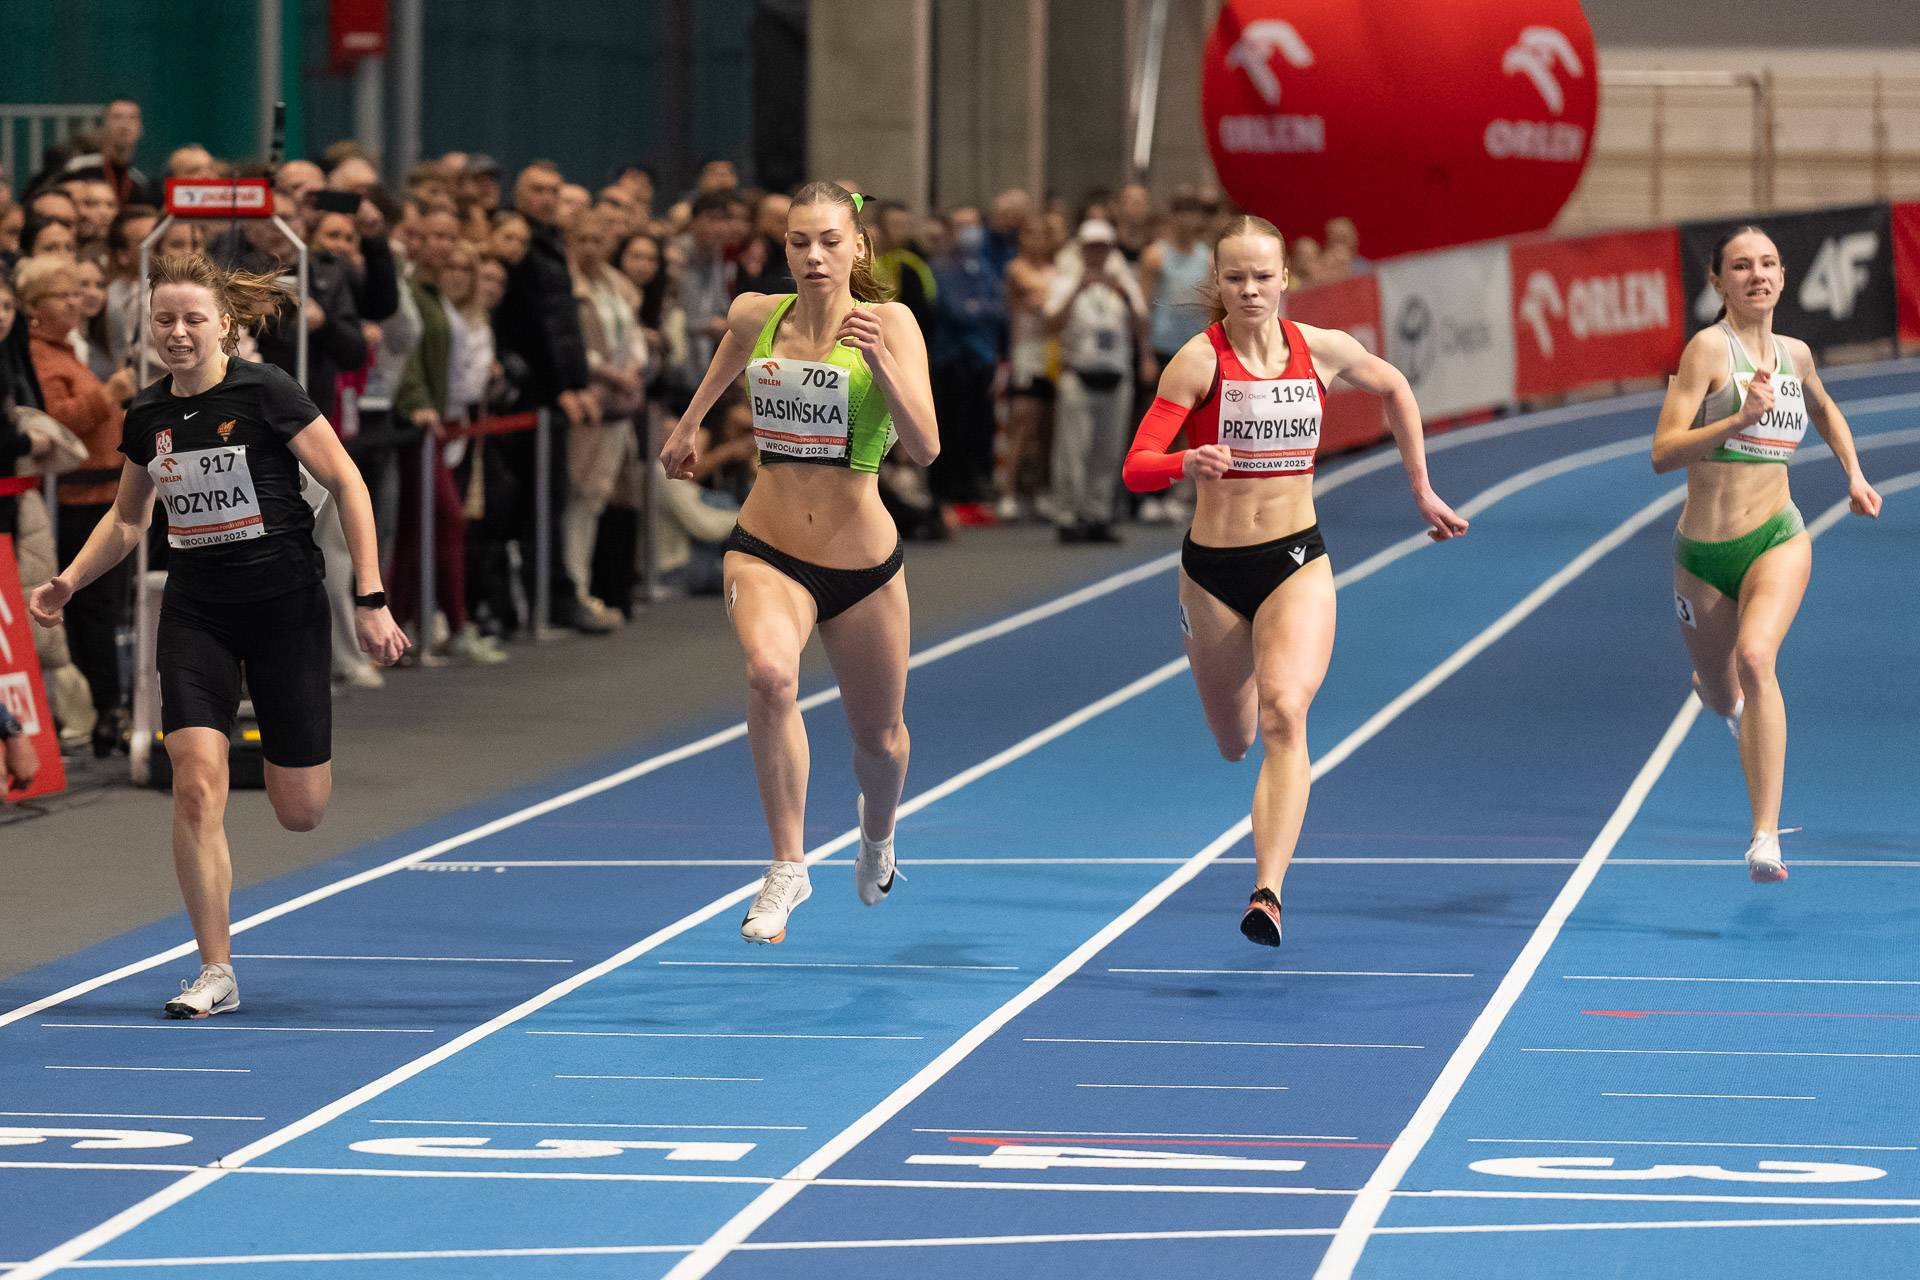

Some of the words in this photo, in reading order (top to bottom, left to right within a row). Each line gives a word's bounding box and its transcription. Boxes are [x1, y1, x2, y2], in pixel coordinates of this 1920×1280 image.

[1800, 231, 1880, 320] 4F
[1567, 270, 1669, 341] ORLEN
[758, 378, 781, 386] ORLEN
[801, 367, 839, 389] 702
[1271, 386, 1317, 404] 1194
[754, 396, 843, 425] BASIŃSKA
[1759, 410, 1803, 431] OWAK
[1222, 417, 1318, 440] PRZYBYLSKA
[765, 441, 804, 455] WROCŁAW
[805, 447, 829, 455] 2025
[199, 452, 236, 475] 917
[1232, 460, 1283, 469] WROCŁAW
[1284, 459, 1306, 468] 2025
[160, 475, 183, 484] ORLEN
[180, 534, 222, 547] WROCŁAW
[223, 530, 248, 541] 2025
[1676, 595, 1691, 622] 3
